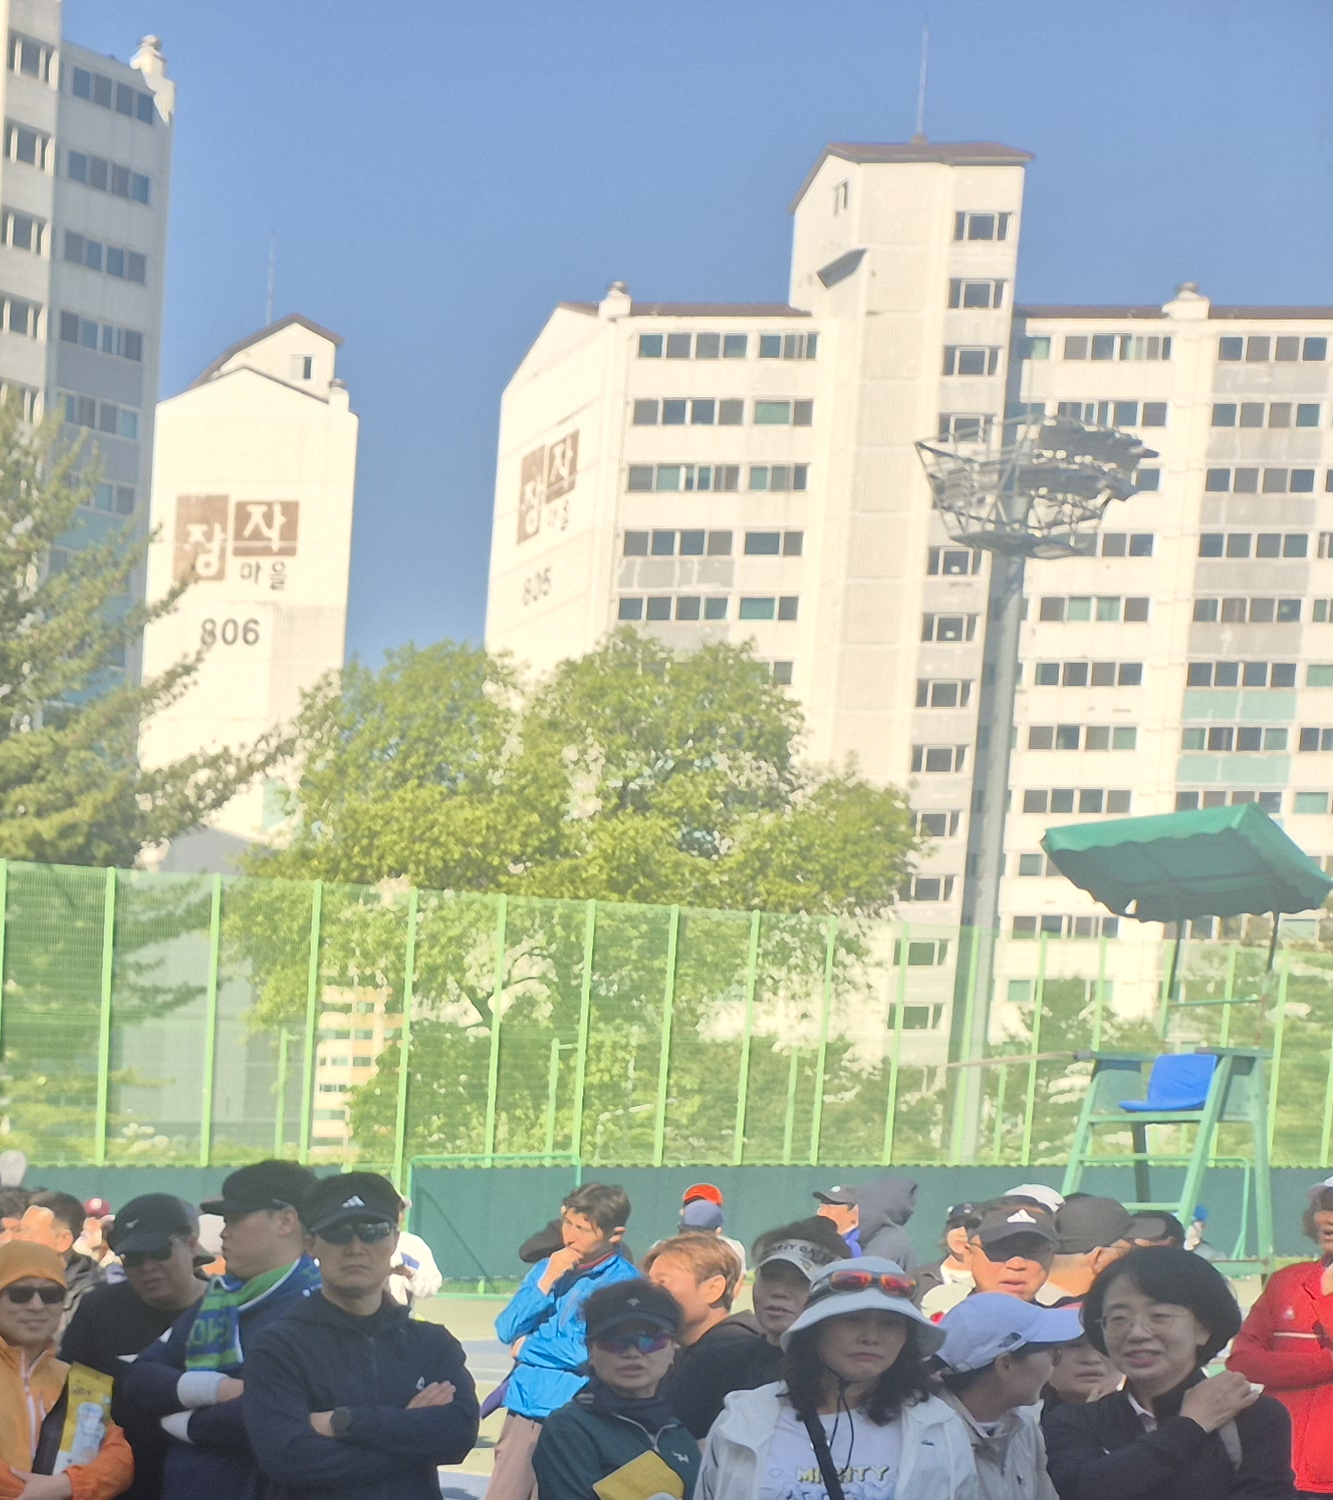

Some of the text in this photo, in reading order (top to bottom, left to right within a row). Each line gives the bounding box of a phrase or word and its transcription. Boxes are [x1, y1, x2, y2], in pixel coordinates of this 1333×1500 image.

[240, 561, 286, 591] 마을
[199, 617, 261, 646] 806
[797, 1466, 890, 1484] MIHTY
